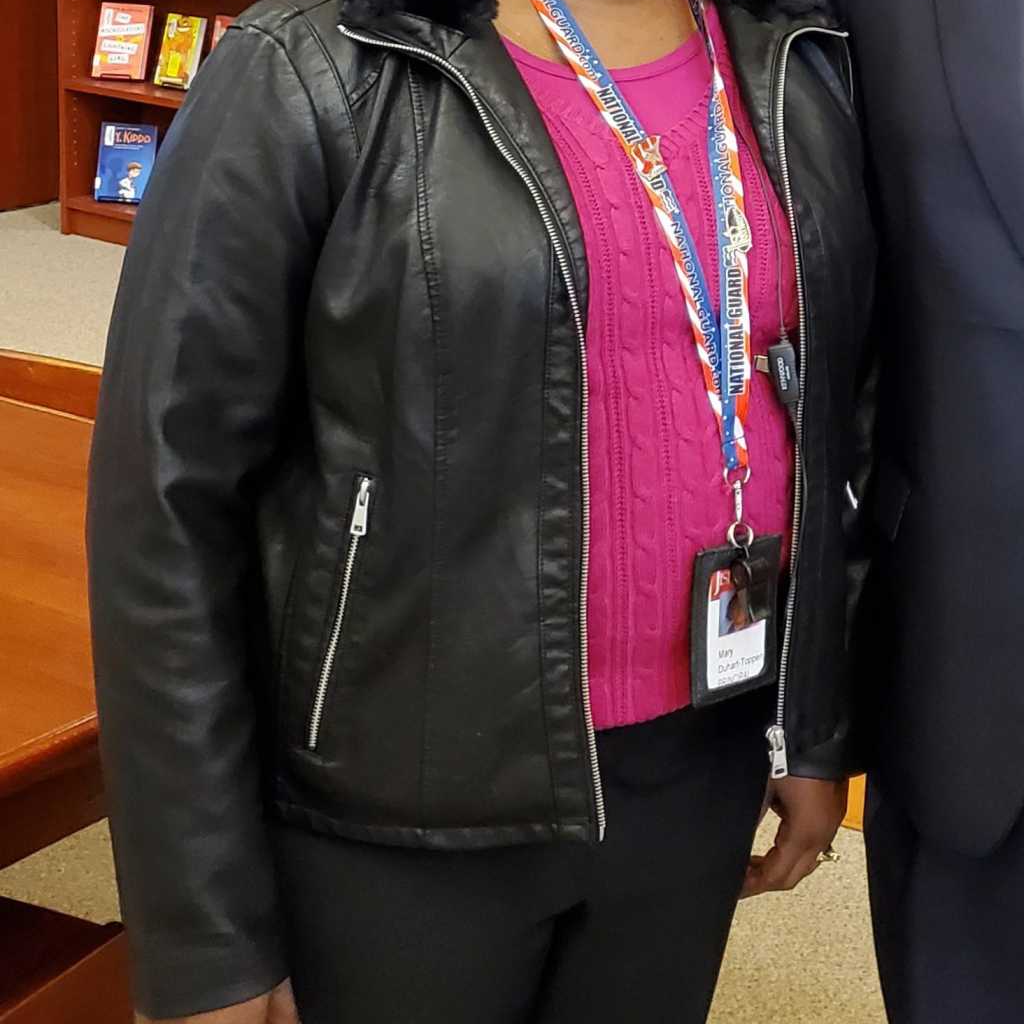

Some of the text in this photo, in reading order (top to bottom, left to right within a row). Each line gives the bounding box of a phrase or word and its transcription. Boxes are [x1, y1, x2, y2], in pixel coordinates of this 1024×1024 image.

[597, 87, 641, 146] NATIONAL
[728, 269, 744, 395] NATIONAL GUARD
